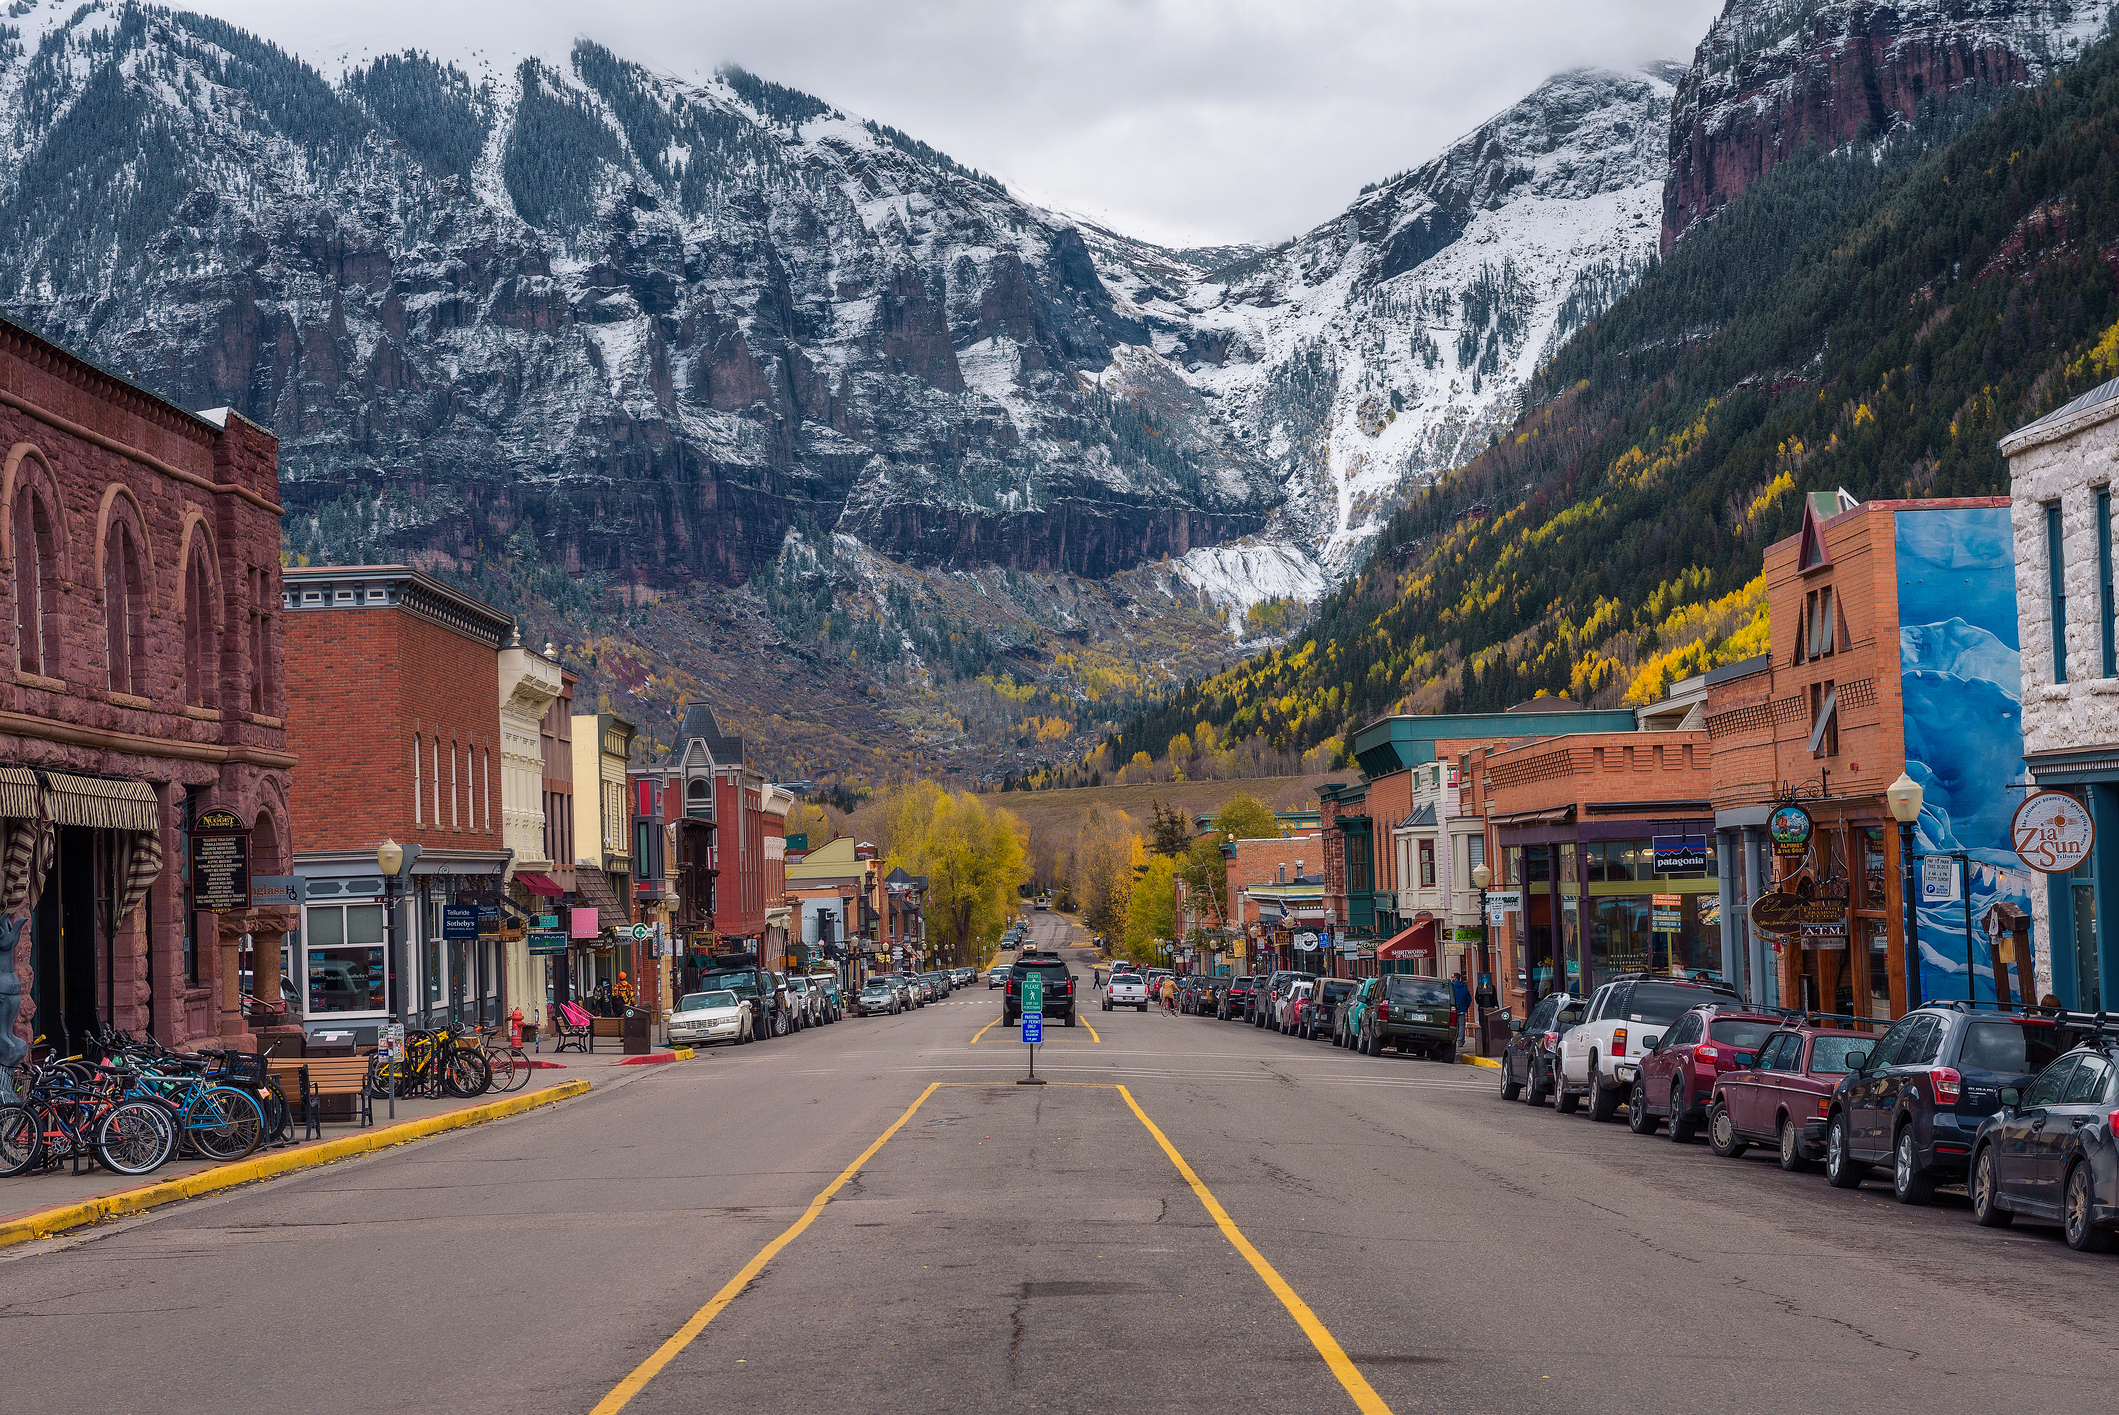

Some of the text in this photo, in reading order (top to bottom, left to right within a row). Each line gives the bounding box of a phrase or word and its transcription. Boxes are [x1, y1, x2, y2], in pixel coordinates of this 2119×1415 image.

[2025, 801, 2041, 818] ultimate
[203, 816, 234, 828] NUGGET
[2015, 822, 2058, 853] Zia
[2039, 840, 2082, 867] Sun
[1657, 857, 1703, 866] patagonia
[251, 884, 286, 898] nglass
[447, 920, 475, 928] Sotheby's
[1457, 931, 1483, 940] sublim
